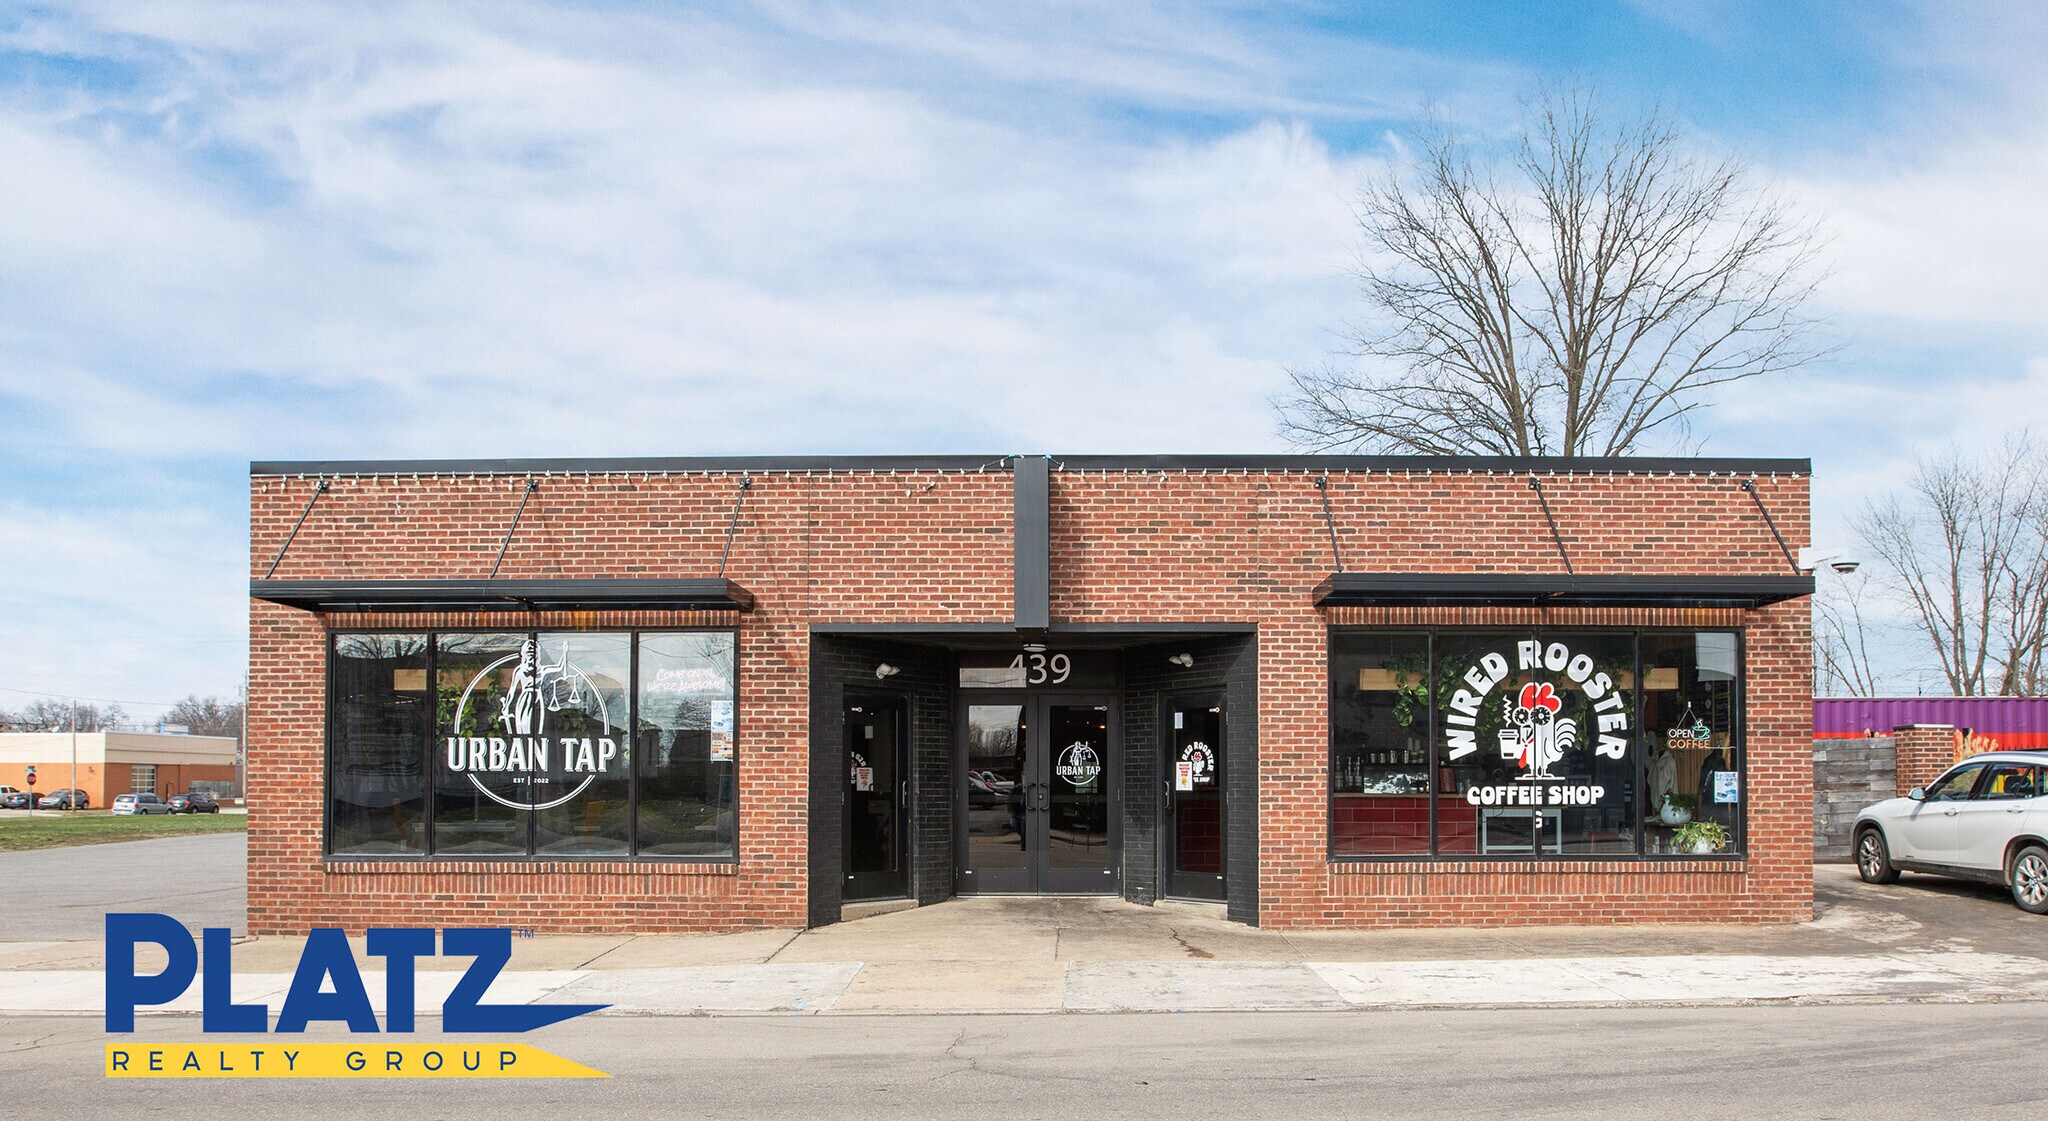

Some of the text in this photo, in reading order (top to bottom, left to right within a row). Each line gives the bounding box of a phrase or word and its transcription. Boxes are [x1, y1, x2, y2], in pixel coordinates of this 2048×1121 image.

[657, 668, 685, 680] COME
[687, 669, 700, 680] ON
[1007, 653, 1071, 684] 439
[1446, 639, 1627, 761] WIRED ROOSTER
[1668, 728, 1695, 739] OPEN
[1668, 739, 1710, 749] COFFEE
[447, 737, 617, 772] URBAN TAP
[1181, 744, 1193, 761] RED
[1193, 741, 1214, 772] ROOSTER
[1056, 765, 1101, 776] URBAN TAP
[1467, 785, 1605, 806] COFFEE SHOP
